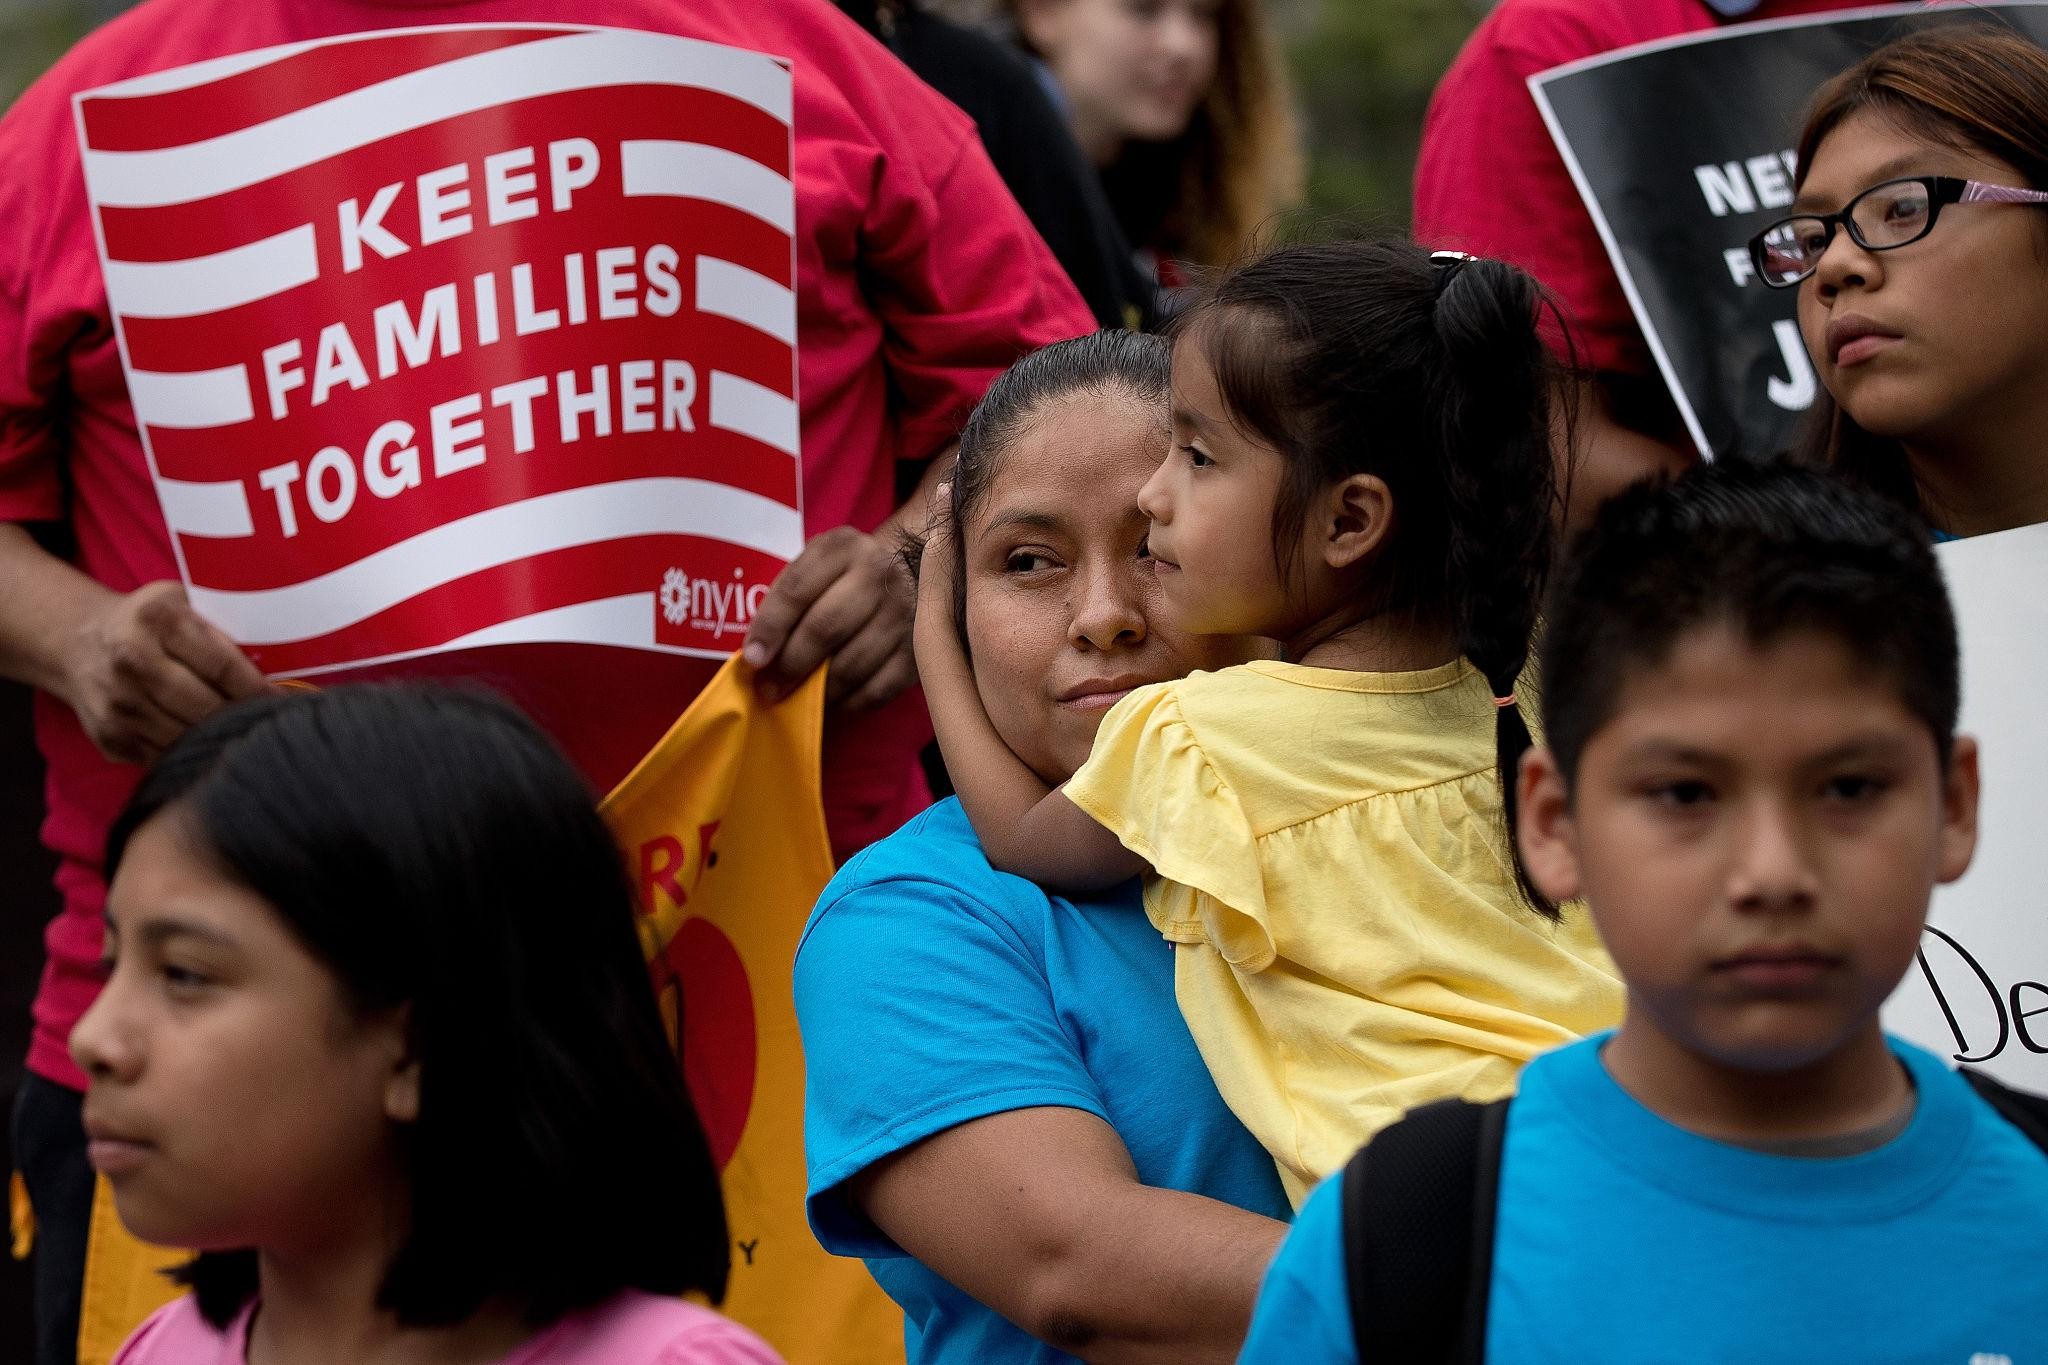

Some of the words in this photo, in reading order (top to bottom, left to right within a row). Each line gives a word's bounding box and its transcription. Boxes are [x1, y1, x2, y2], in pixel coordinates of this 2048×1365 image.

[337, 137, 601, 274] KEEP
[261, 243, 683, 420] FAMILIES
[259, 358, 698, 538] TOGETHER
